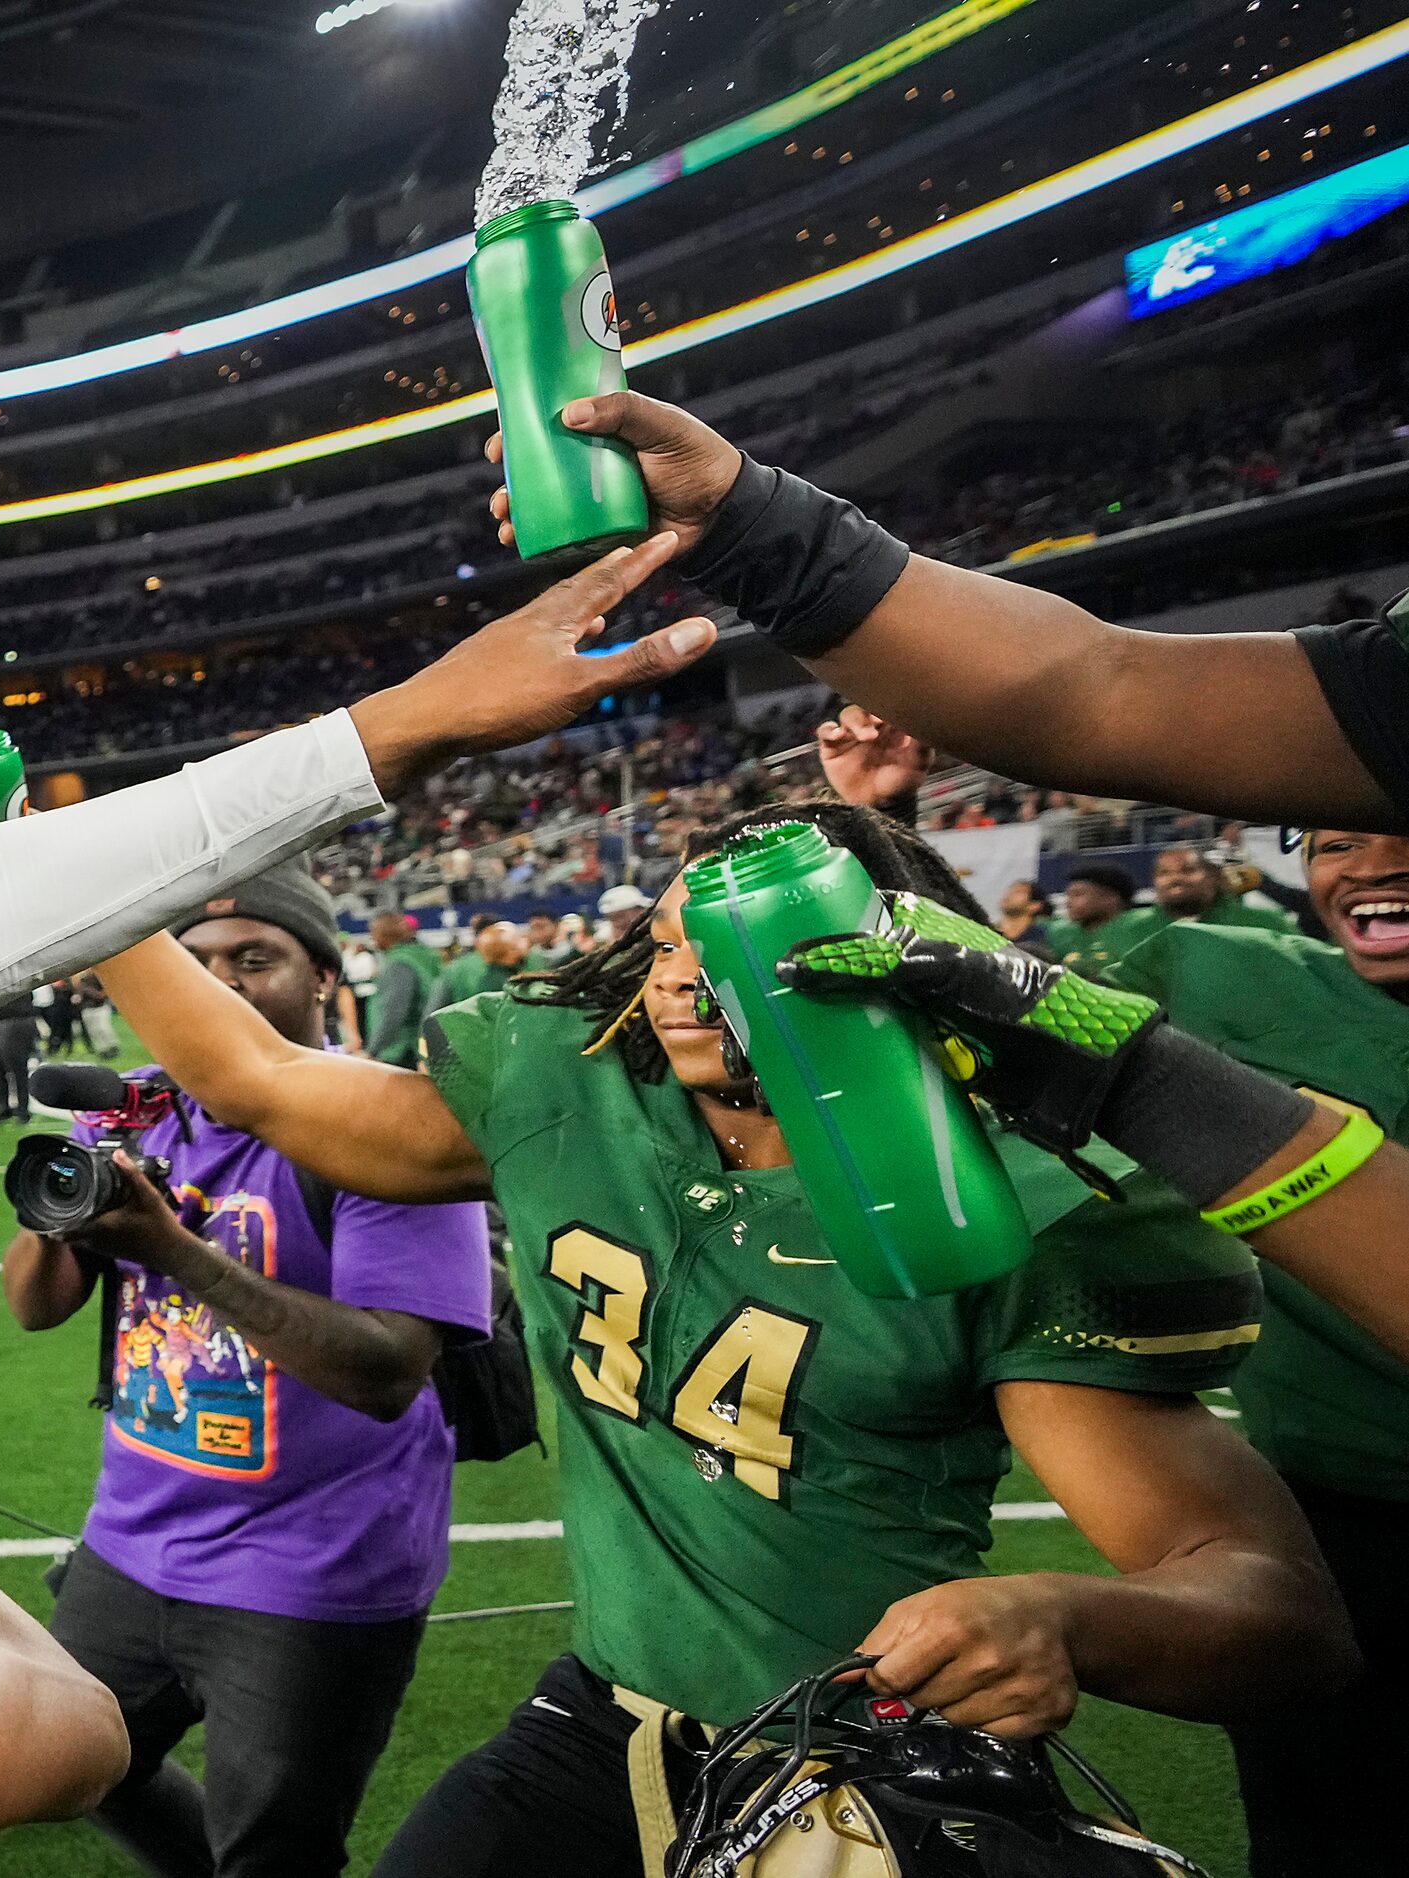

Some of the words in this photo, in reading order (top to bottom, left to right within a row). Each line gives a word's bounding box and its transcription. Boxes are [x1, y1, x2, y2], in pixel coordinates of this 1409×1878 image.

[1221, 1204, 1267, 1229] FIND
[1267, 1195, 1285, 1210] A
[1282, 1162, 1331, 1199] WAY
[546, 1223, 812, 1503] 34
